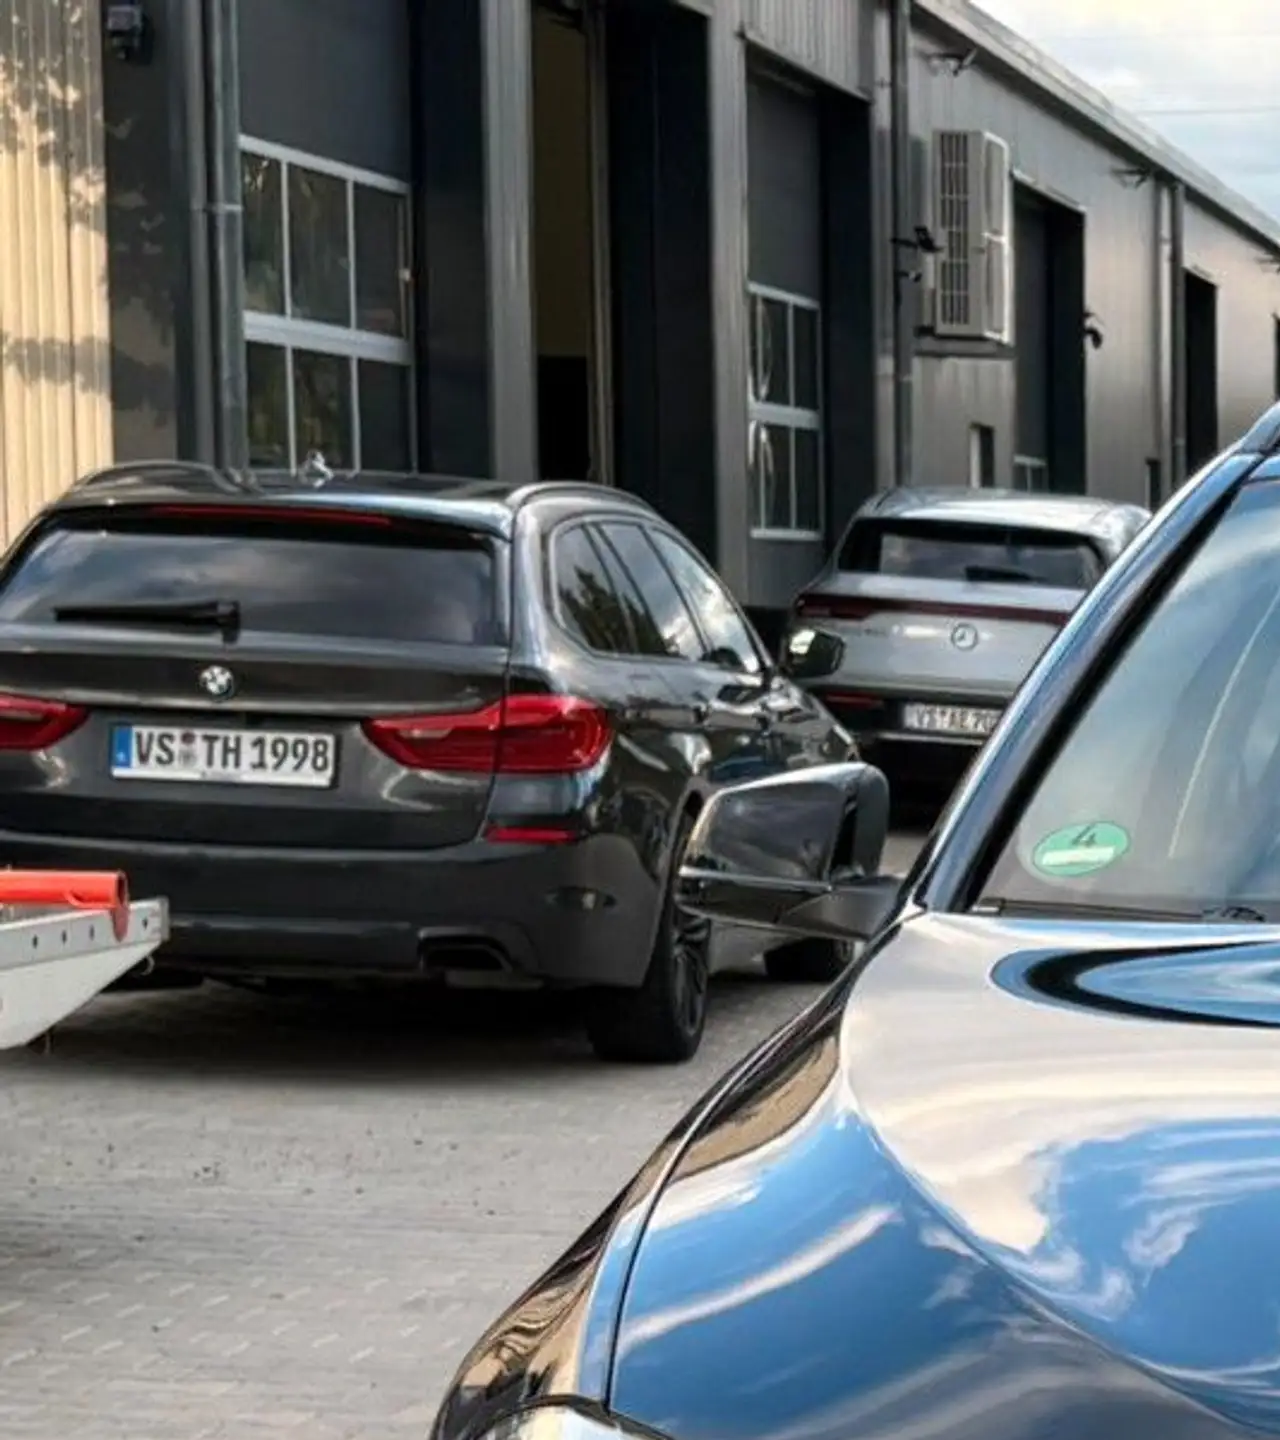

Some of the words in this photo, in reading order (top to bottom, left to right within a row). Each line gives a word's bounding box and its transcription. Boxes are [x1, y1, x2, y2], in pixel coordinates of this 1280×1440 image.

[135, 731, 175, 765] VS
[201, 735, 242, 769] TH
[251, 737, 330, 772] 1998
